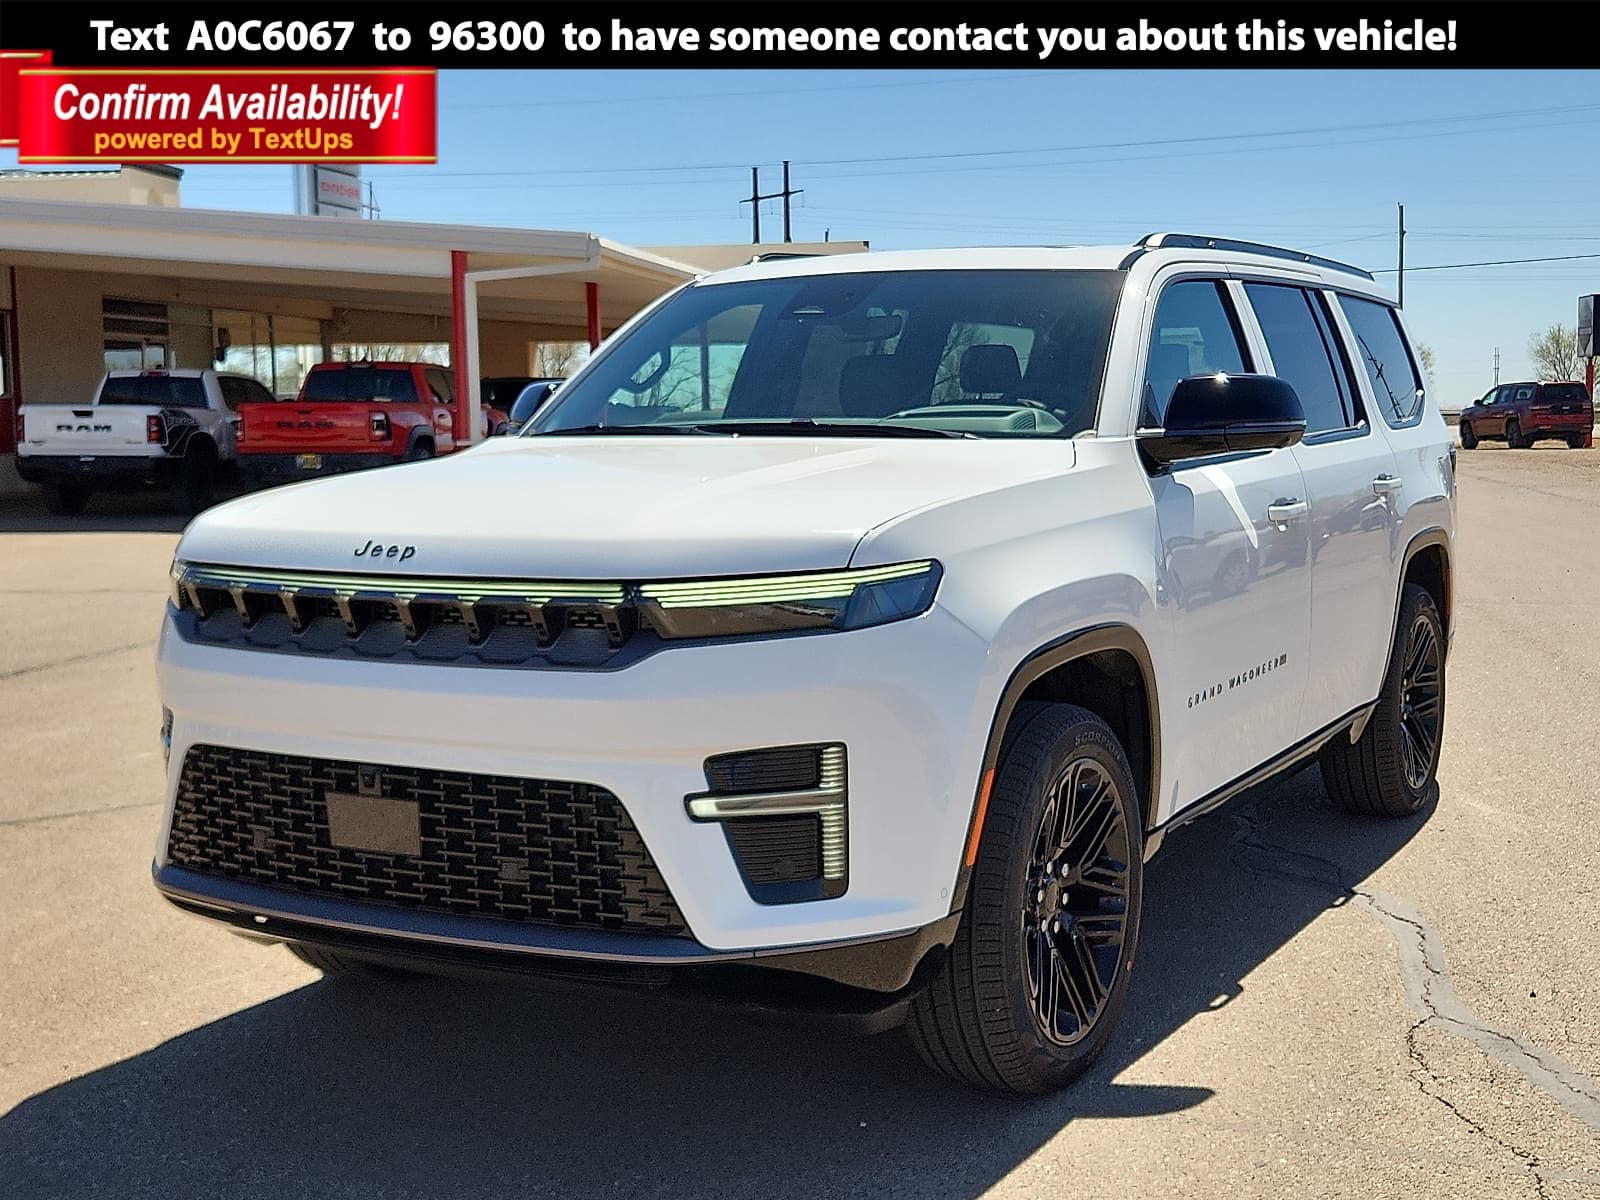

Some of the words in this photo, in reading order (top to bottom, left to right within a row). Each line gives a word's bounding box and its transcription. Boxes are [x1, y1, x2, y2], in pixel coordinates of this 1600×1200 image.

[56, 424, 112, 433] RAM
[354, 540, 416, 562] Jeep
[1187, 683, 1222, 709] GRAND
[1228, 658, 1279, 690] WAGONEER
